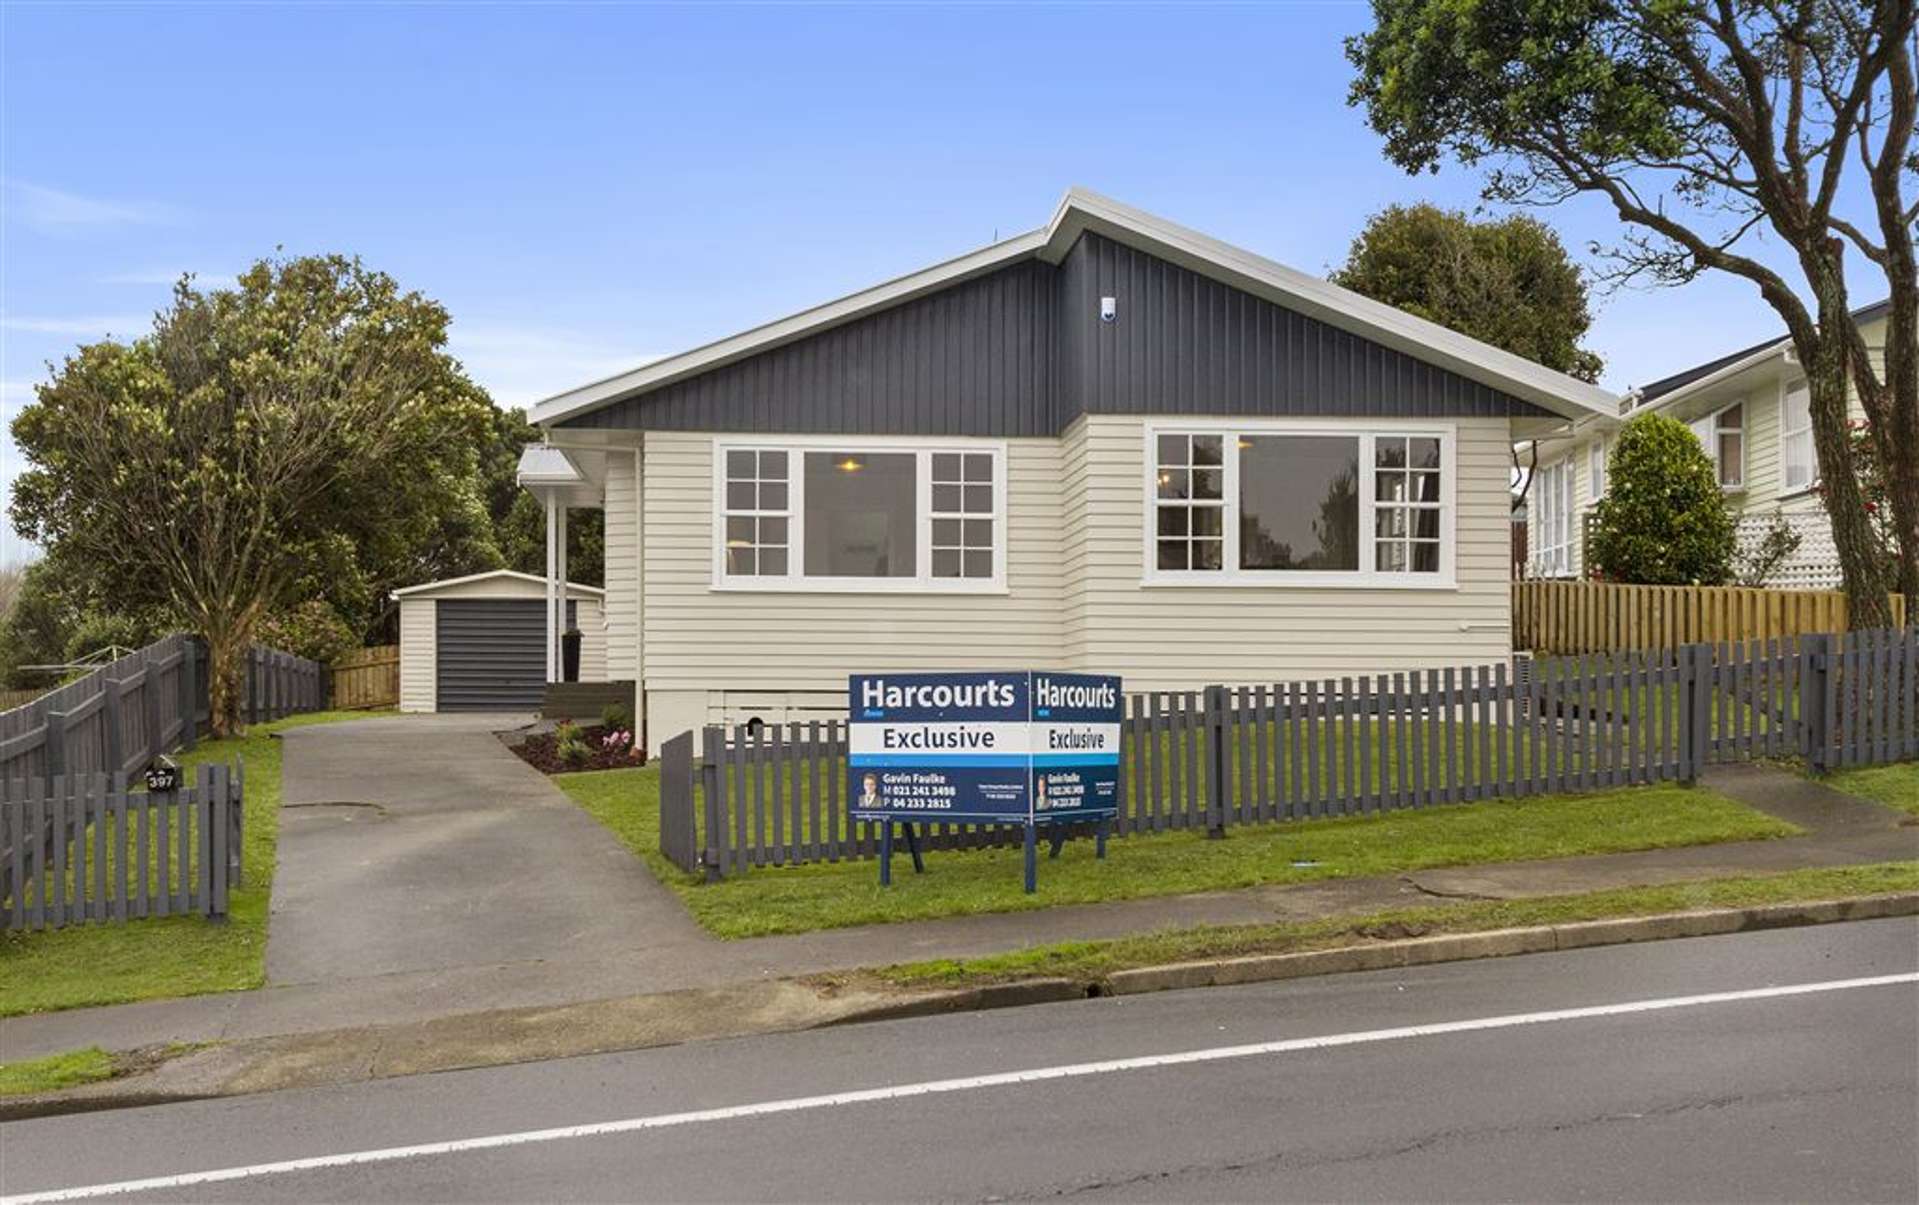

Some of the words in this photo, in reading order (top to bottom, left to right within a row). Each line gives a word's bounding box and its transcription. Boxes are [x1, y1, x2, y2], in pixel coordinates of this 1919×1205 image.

[862, 679, 1015, 708] Harcourts
[1037, 678, 1116, 709] Harcourts
[883, 725, 995, 749] Exclusive
[1049, 727, 1105, 749] Exclusive
[149, 775, 173, 788] 397
[882, 773, 912, 784] Gavin
[893, 786, 911, 796] 021
[912, 786, 930, 796] 241
[883, 797, 891, 807] P
